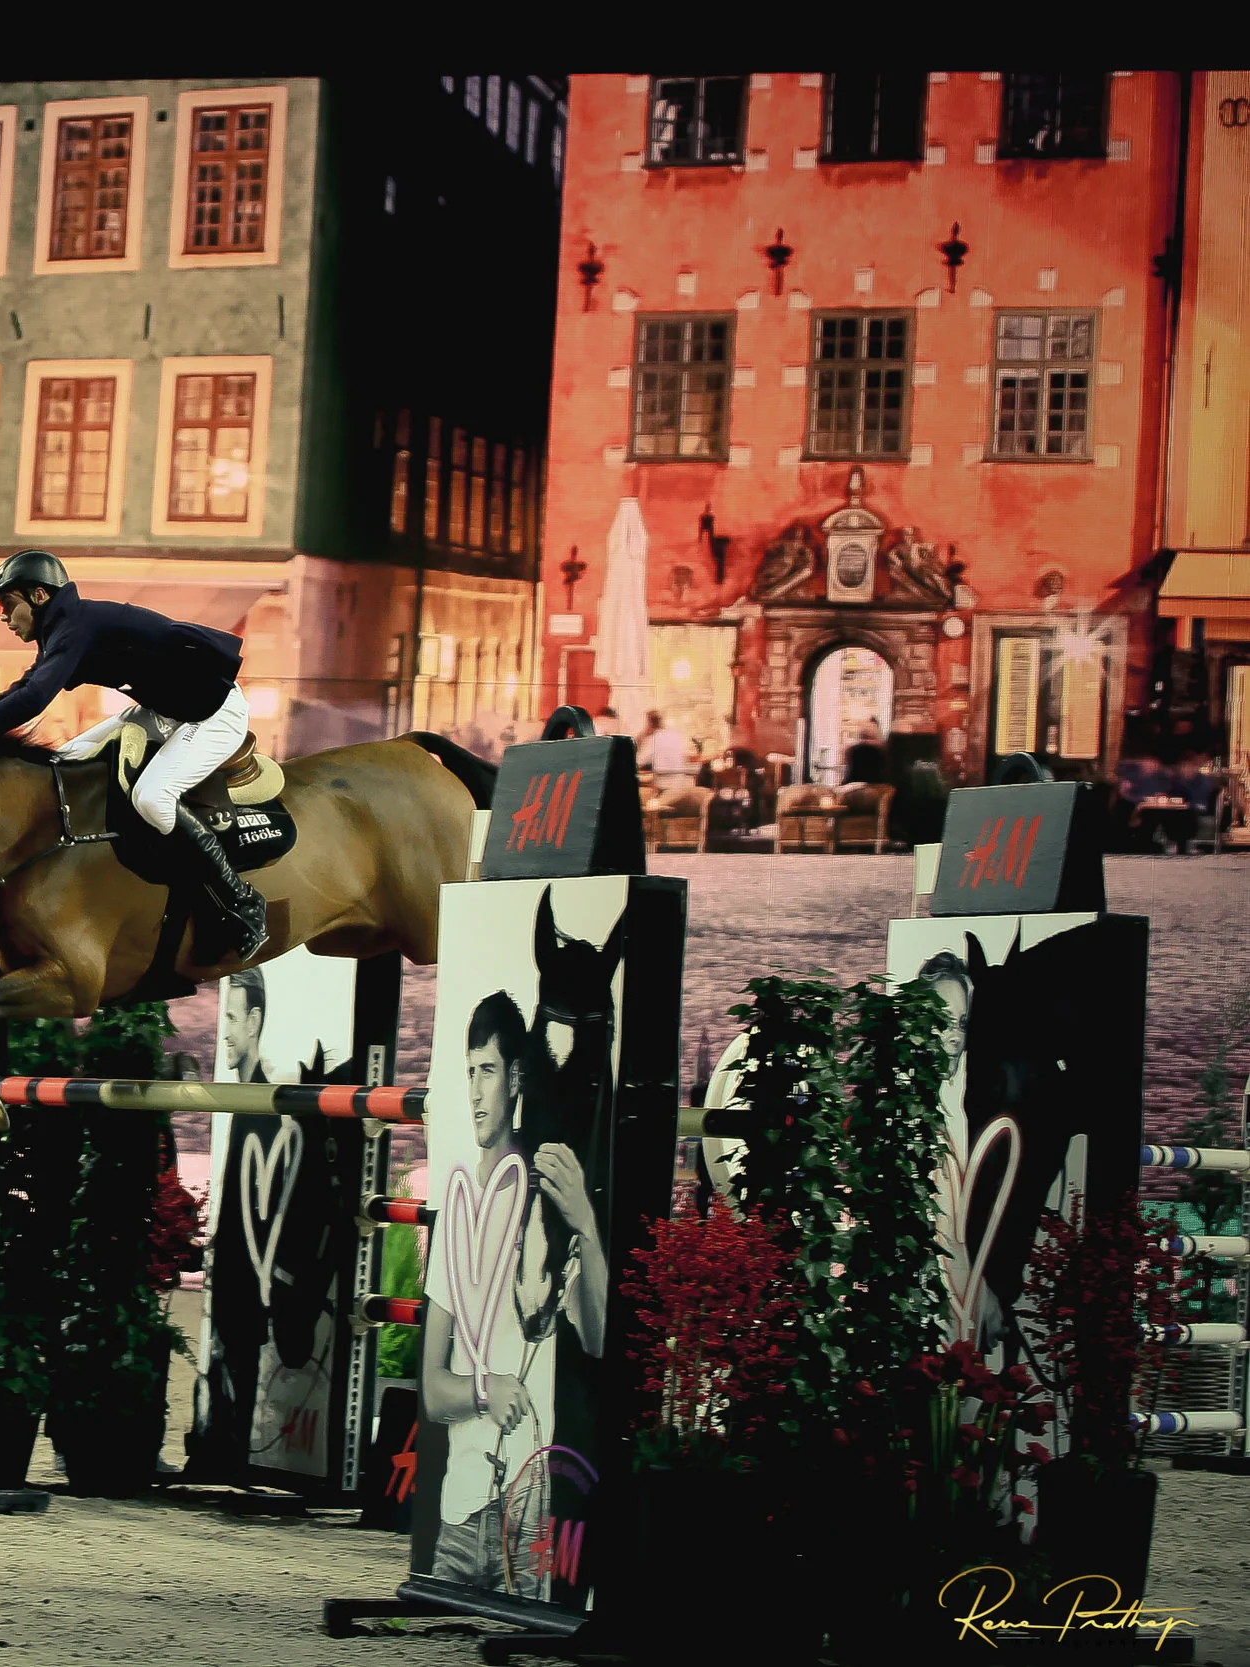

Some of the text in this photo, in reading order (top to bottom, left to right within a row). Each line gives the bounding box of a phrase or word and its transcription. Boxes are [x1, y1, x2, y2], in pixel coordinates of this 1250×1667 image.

[238, 827, 283, 846] Hööks
[505, 768, 583, 852] H&M
[958, 813, 1043, 889] H&M
